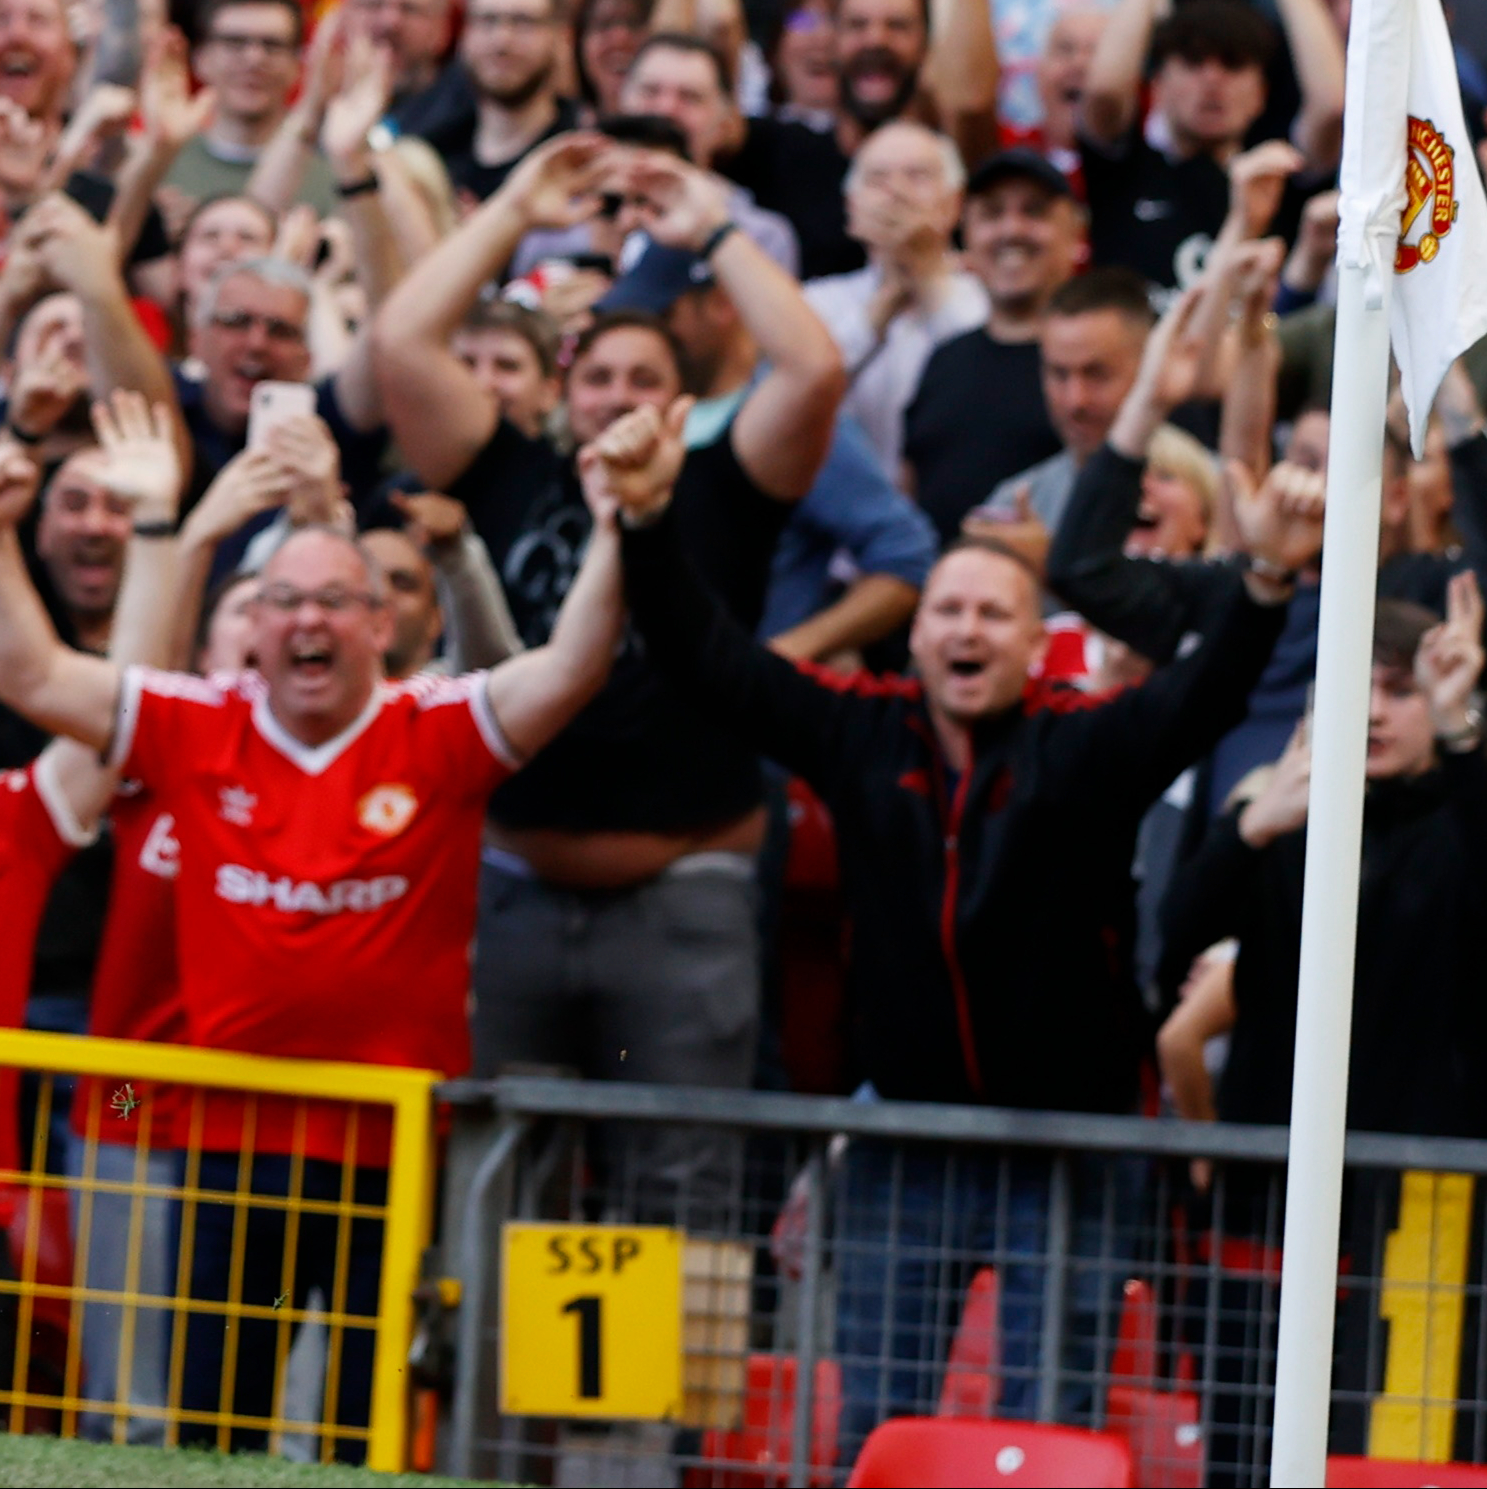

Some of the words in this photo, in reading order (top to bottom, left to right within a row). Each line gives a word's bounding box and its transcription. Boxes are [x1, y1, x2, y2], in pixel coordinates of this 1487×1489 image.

[215, 863, 409, 915] SHARP
[547, 1235, 643, 1276] SSP
[560, 1296, 602, 1401] 1
